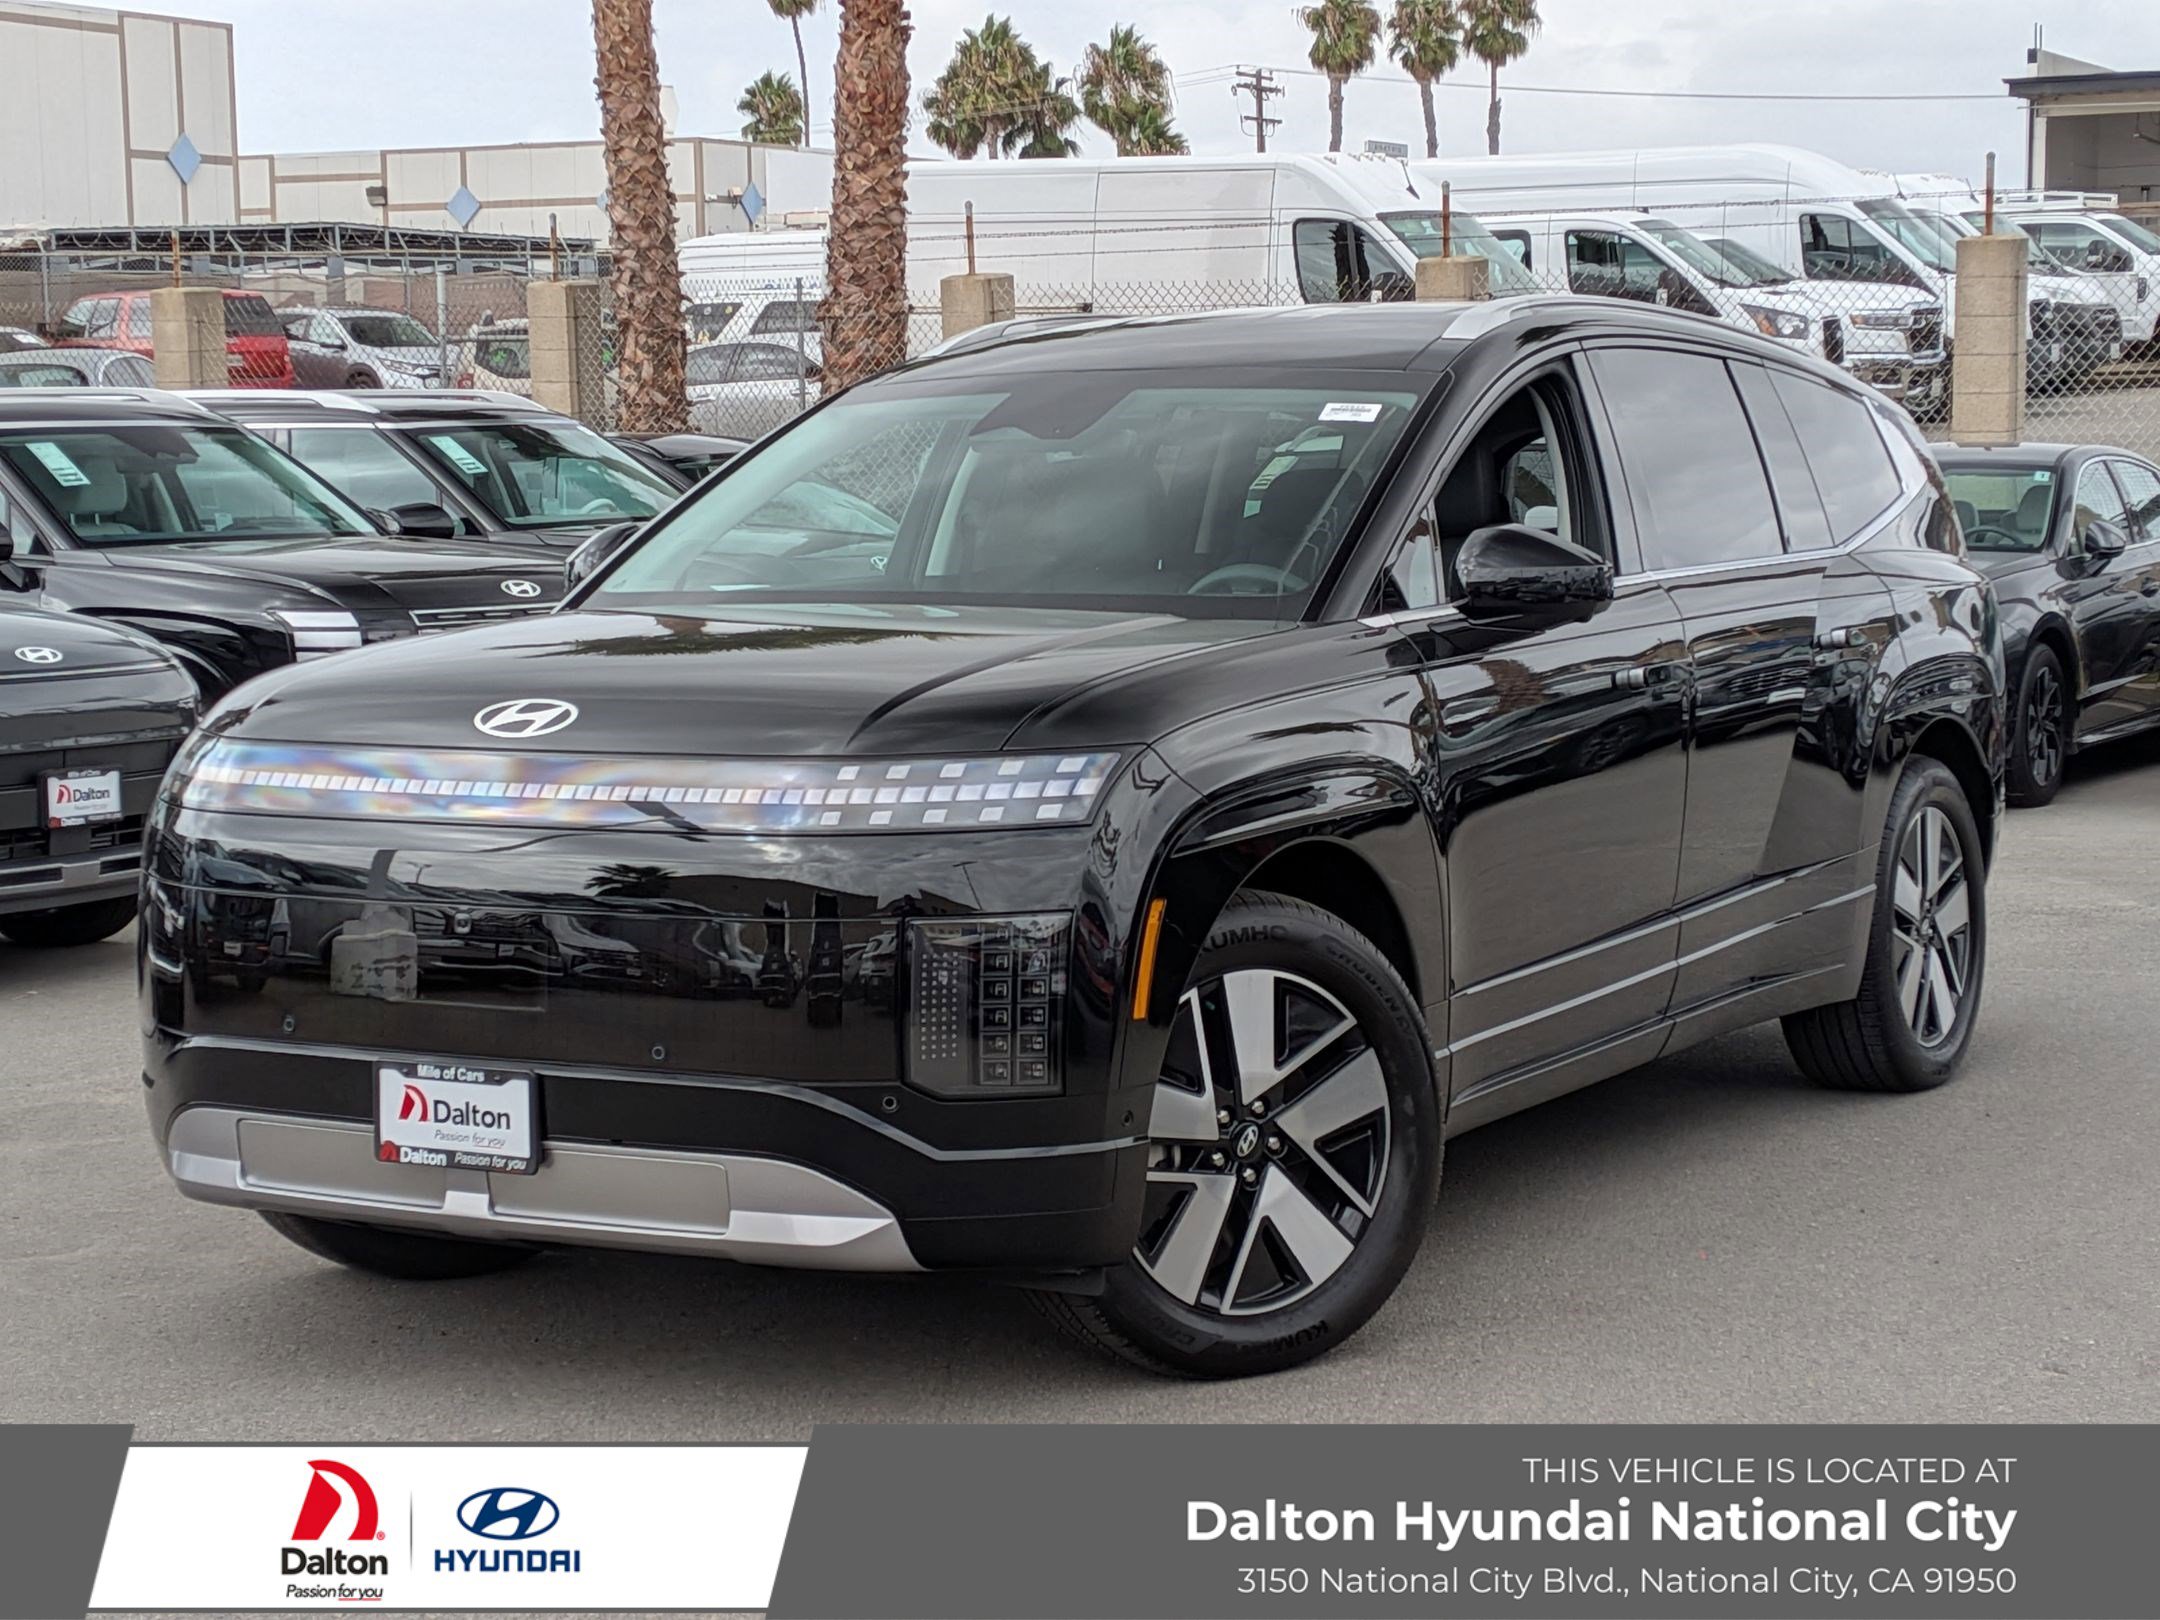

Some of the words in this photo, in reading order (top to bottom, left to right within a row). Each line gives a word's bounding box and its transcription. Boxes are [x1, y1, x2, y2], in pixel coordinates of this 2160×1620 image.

[416, 1064, 441, 1079] Mile
[442, 1066, 456, 1080] of
[457, 1068, 485, 1082] Cars
[433, 1099, 511, 1130] Dalton
[434, 1129, 470, 1143] Passion
[472, 1132, 487, 1145] for
[488, 1138, 506, 1147] you
[400, 1147, 447, 1167] Dalton
[454, 1152, 491, 1167] Passion
[491, 1157, 506, 1168] for
[506, 1159, 527, 1171] you
